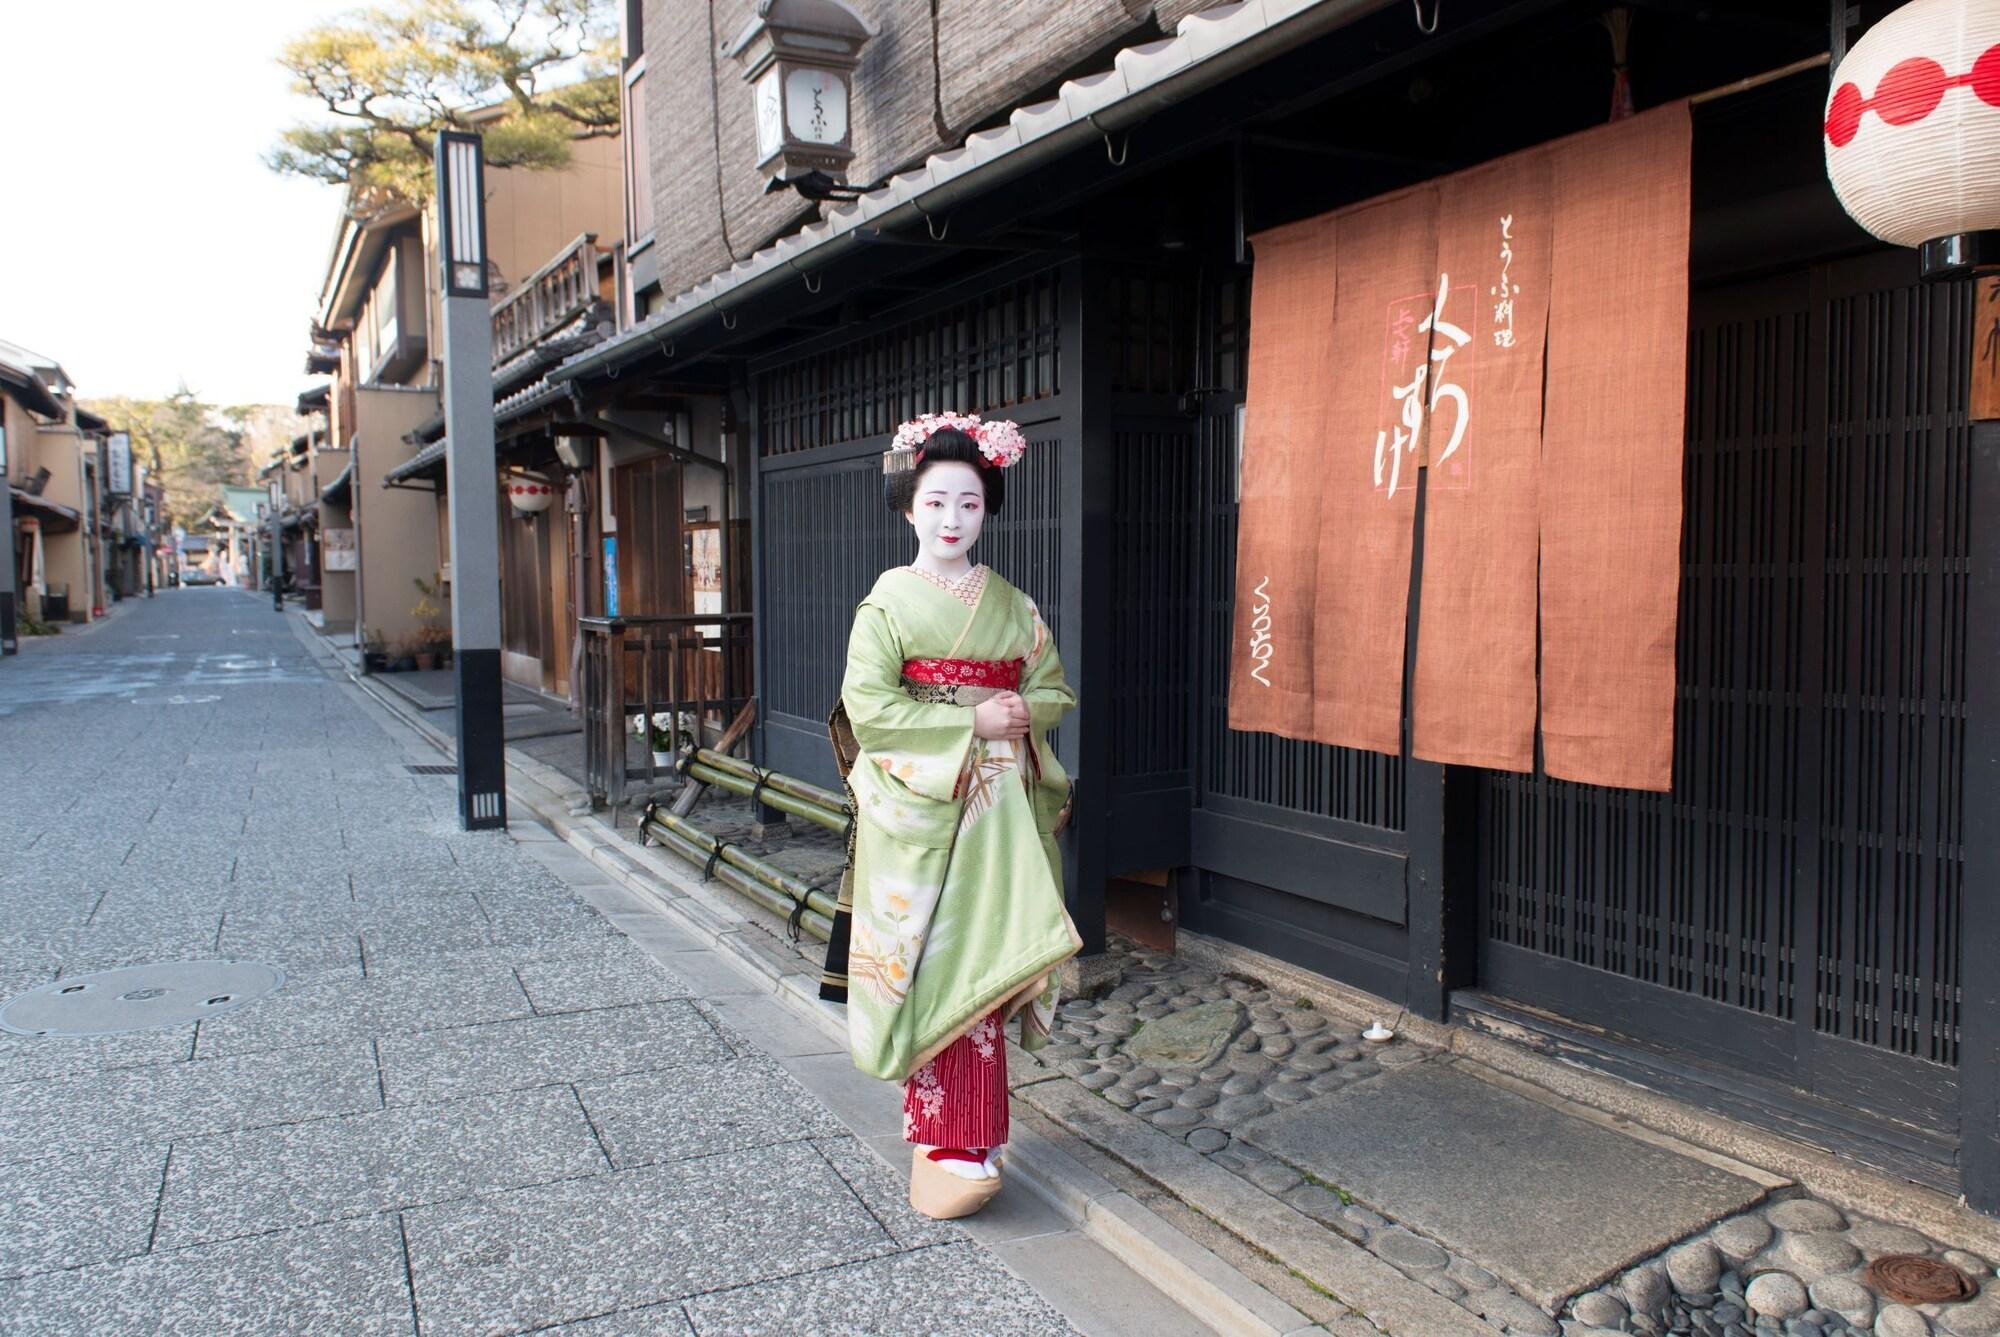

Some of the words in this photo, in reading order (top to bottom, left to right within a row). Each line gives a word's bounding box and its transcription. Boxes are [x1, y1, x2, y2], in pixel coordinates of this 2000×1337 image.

[1490, 213, 1520, 348] とうふ料理
